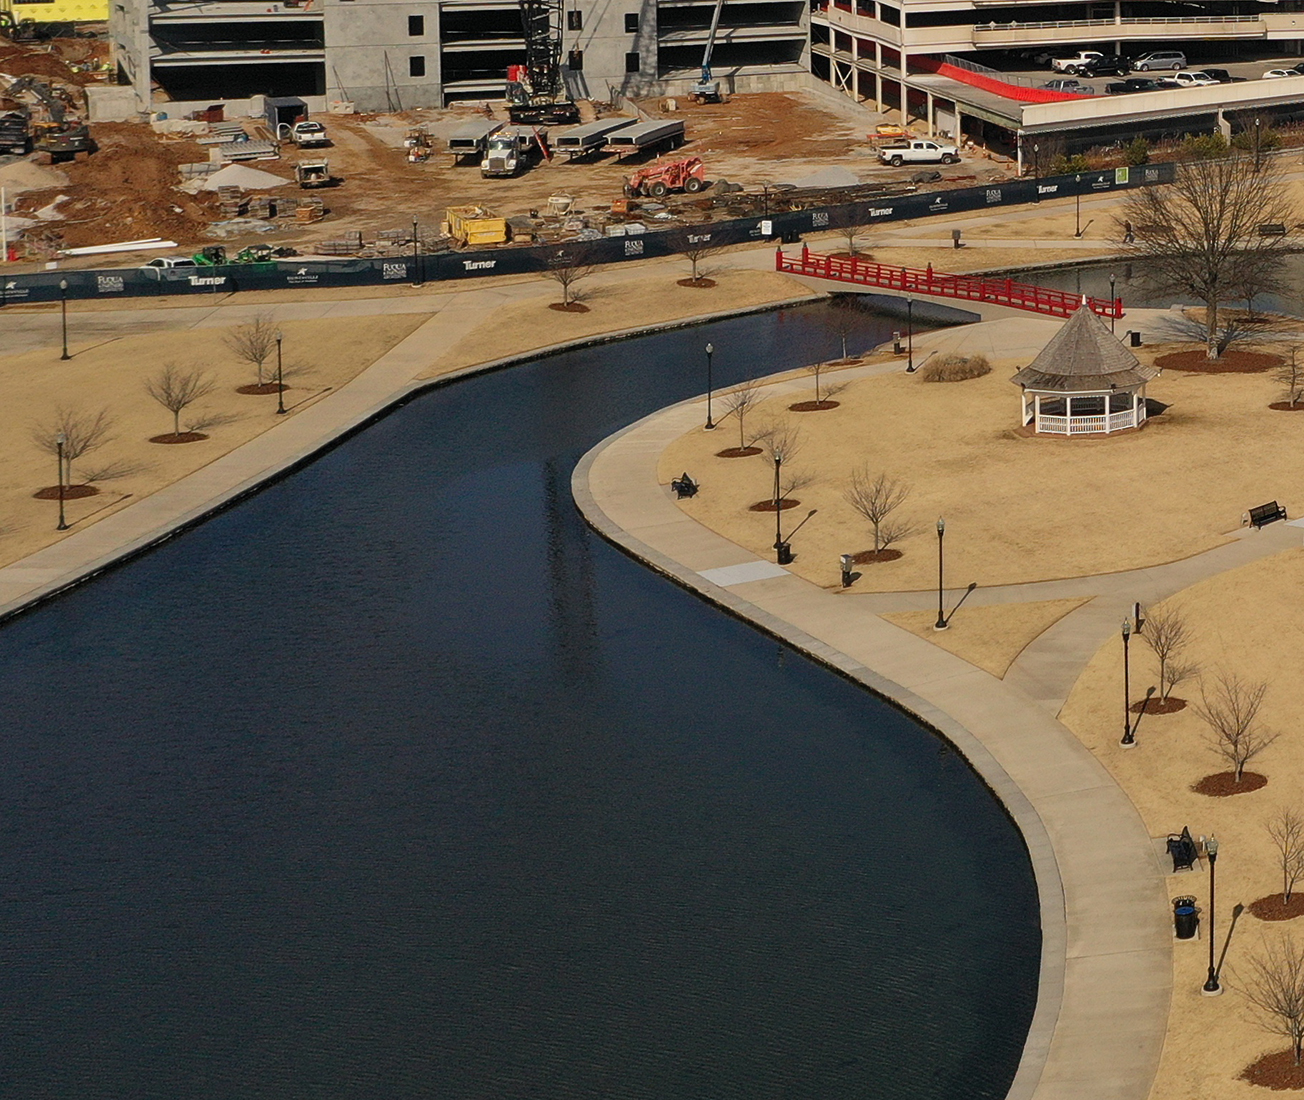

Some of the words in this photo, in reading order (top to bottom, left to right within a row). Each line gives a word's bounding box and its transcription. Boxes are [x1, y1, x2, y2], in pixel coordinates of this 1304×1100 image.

[868, 207, 893, 217] Turner
[463, 260, 496, 270] Turner
[188, 275, 227, 286] Turner
